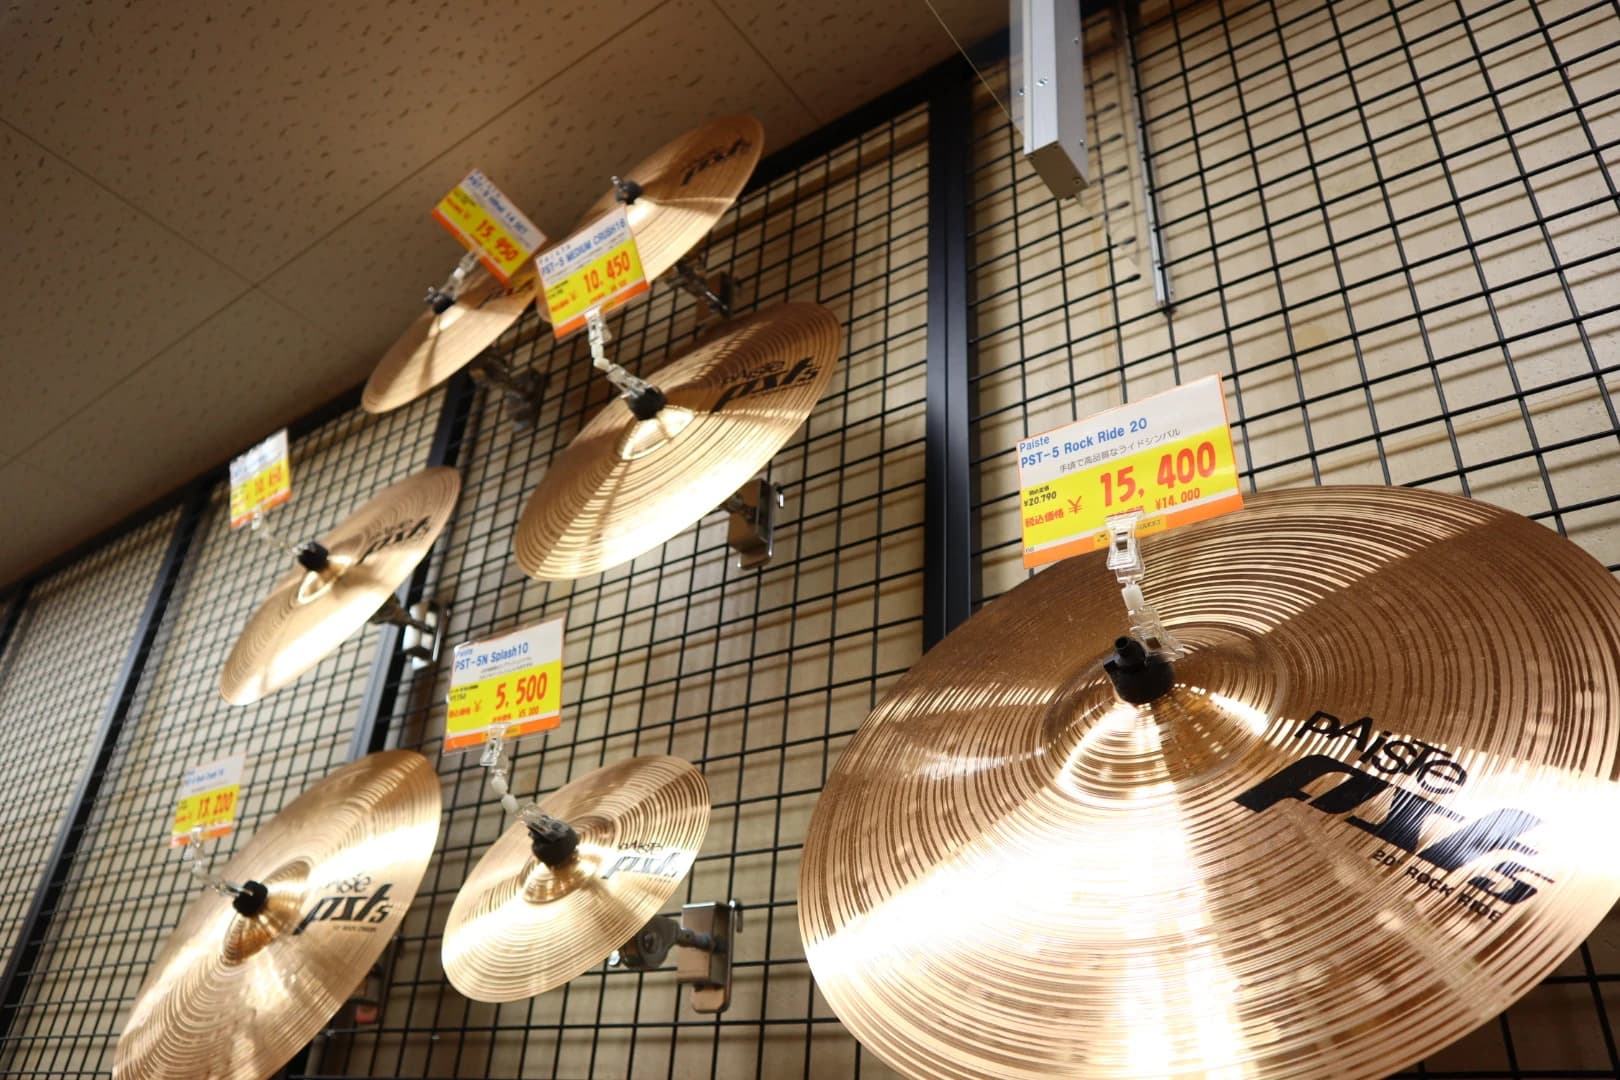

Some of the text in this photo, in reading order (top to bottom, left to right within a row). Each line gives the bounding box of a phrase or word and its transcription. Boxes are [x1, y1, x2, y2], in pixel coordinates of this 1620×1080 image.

[1020, 436, 1050, 452] Paiste
[1021, 418, 1148, 468] PST-5 Rock Ride 20
[1405, 866, 1455, 897] ROCK
[1457, 894, 1504, 923] RIDE
